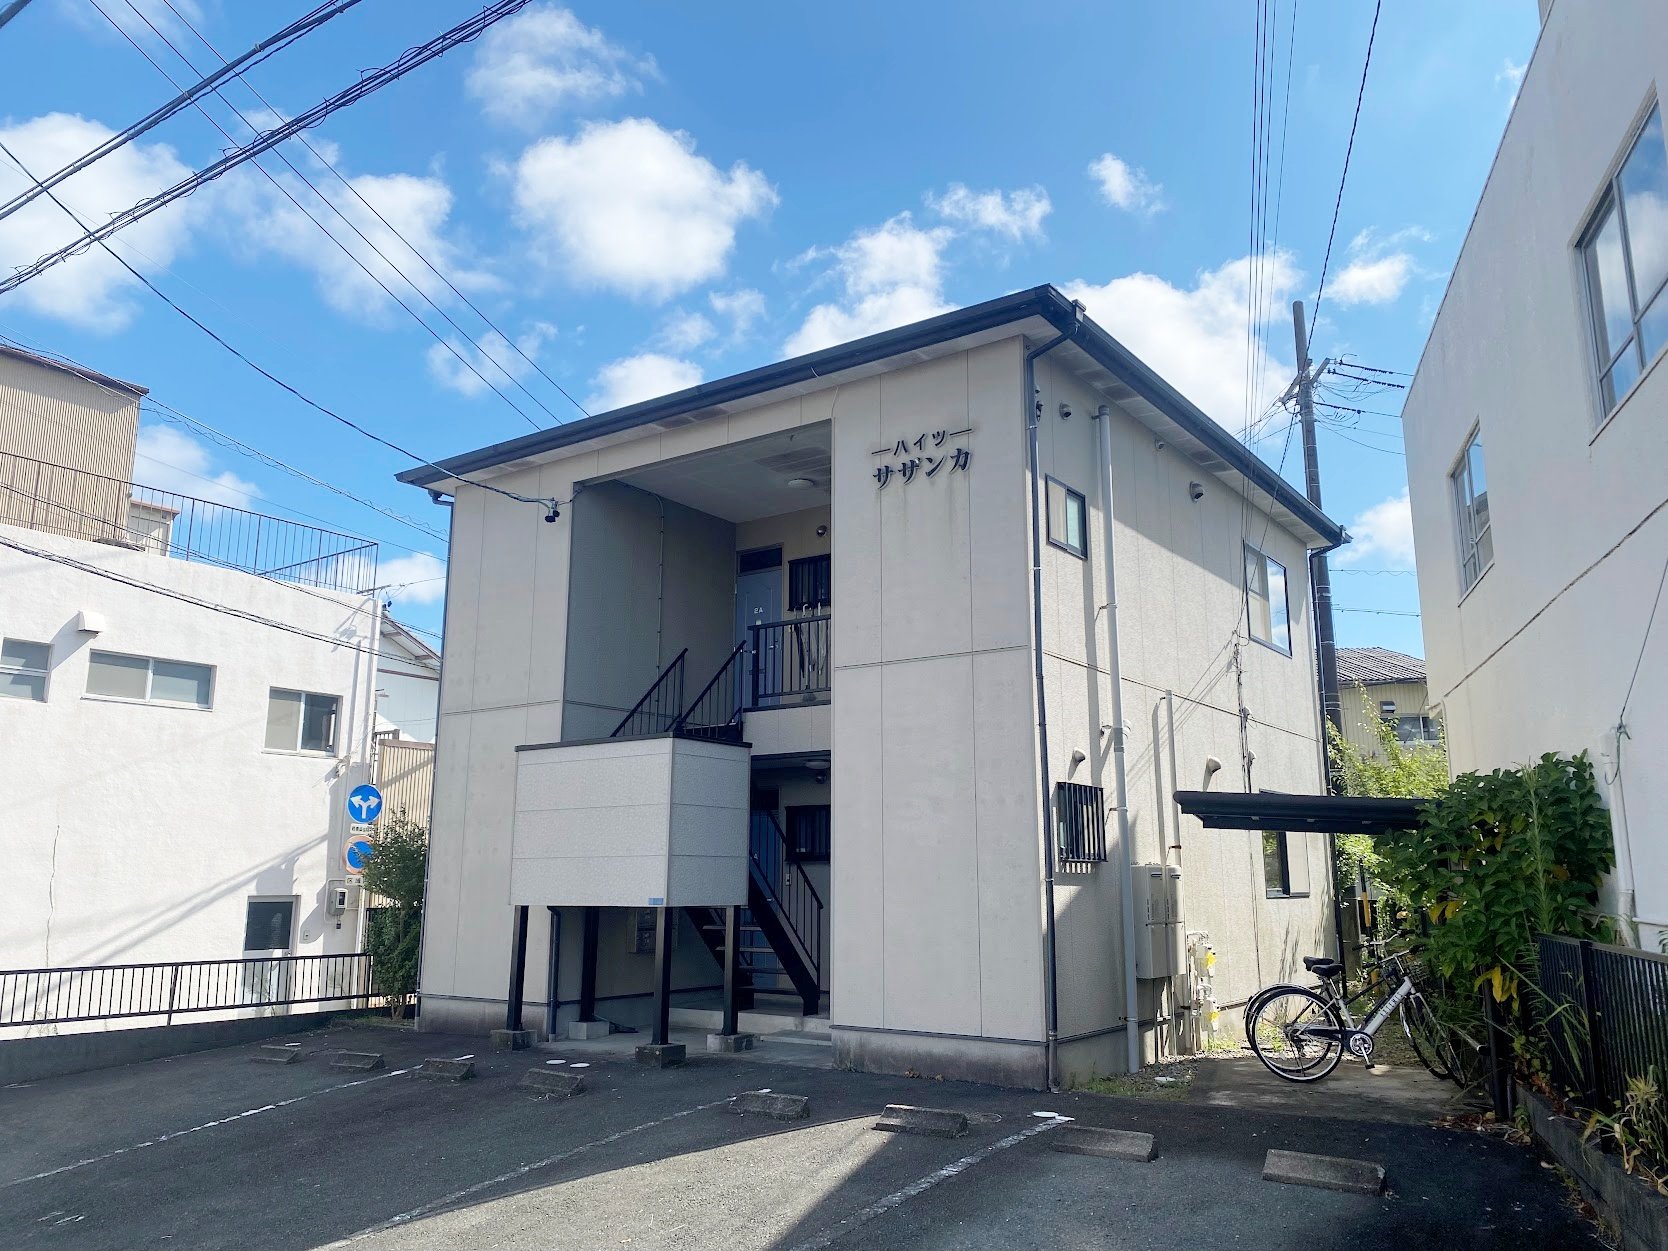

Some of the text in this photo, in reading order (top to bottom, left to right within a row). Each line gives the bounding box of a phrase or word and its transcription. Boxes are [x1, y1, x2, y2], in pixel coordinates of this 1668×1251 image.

[893, 430, 946, 456] ハイツ
[872, 448, 970, 489] サザンカ
